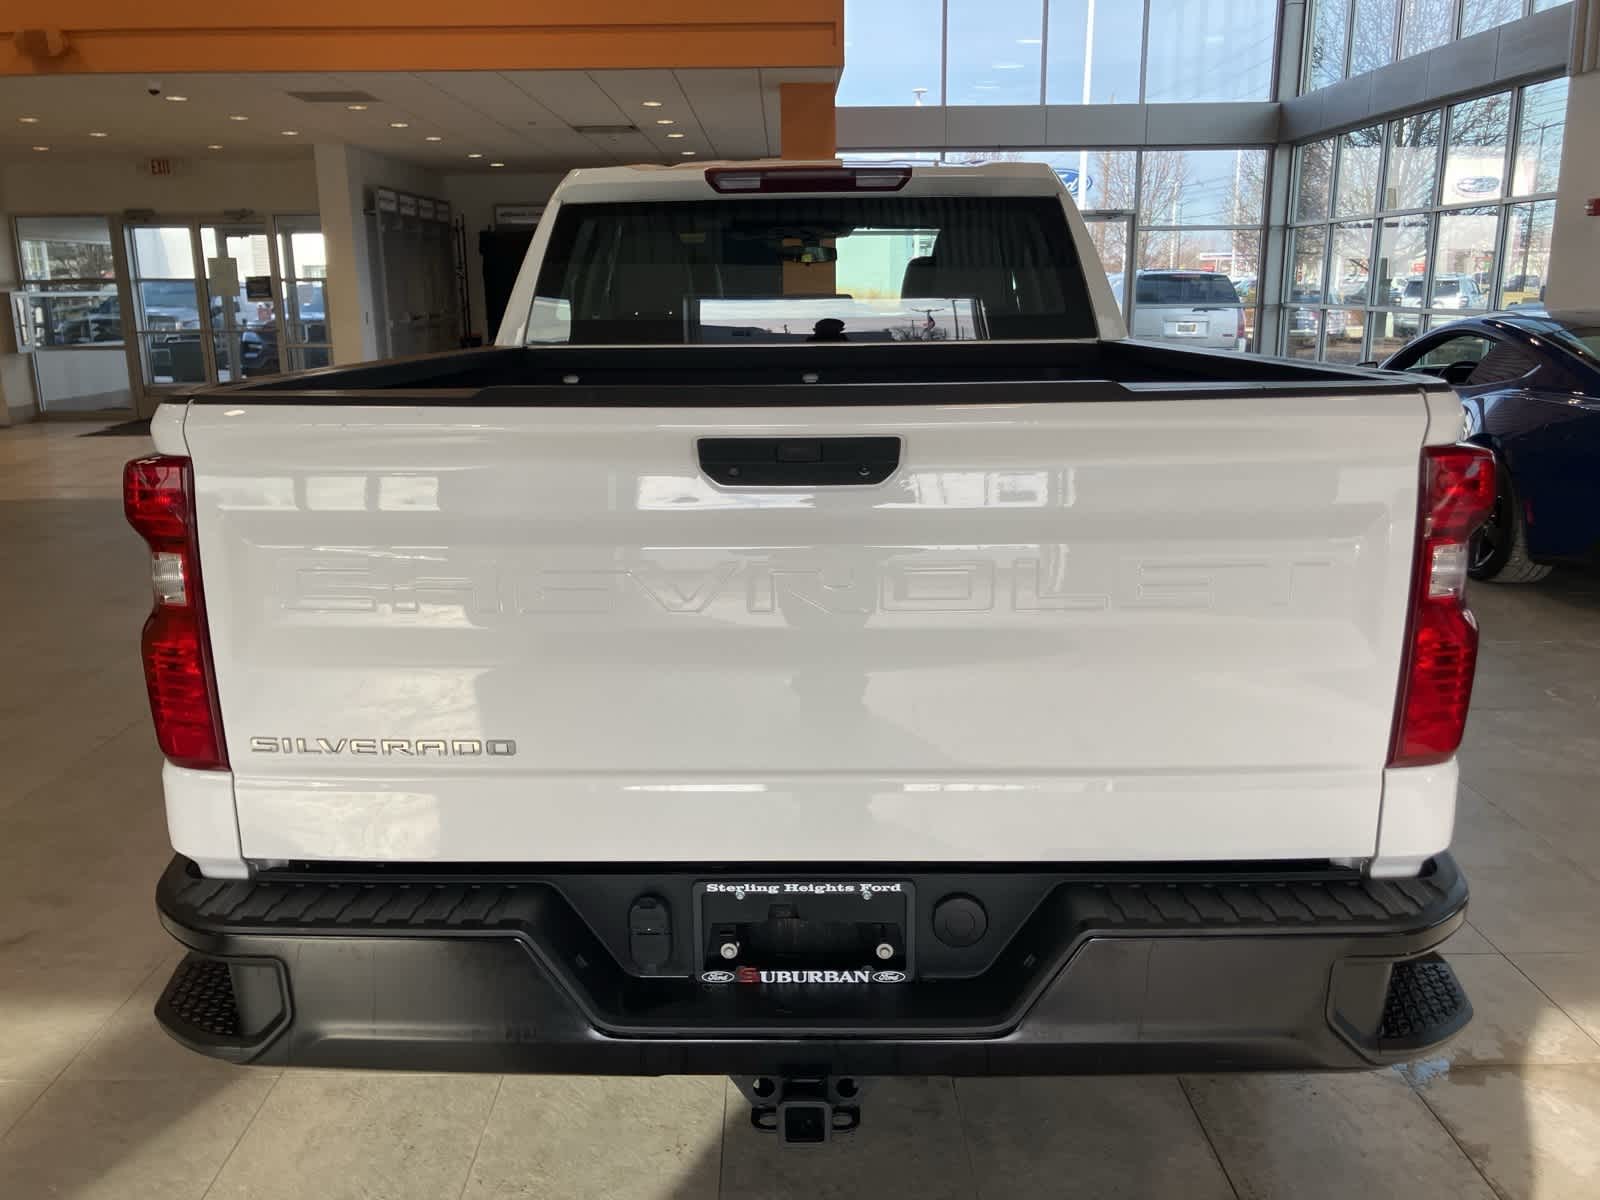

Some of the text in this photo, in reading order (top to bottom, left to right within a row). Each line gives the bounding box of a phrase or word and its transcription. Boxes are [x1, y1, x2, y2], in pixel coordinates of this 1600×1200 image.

[280, 558, 1338, 615] CHEVROLET
[250, 736, 517, 756] SILVERADO
[706, 883, 902, 894] Sterling Heights Ford
[736, 967, 869, 983] SUBURBAN
